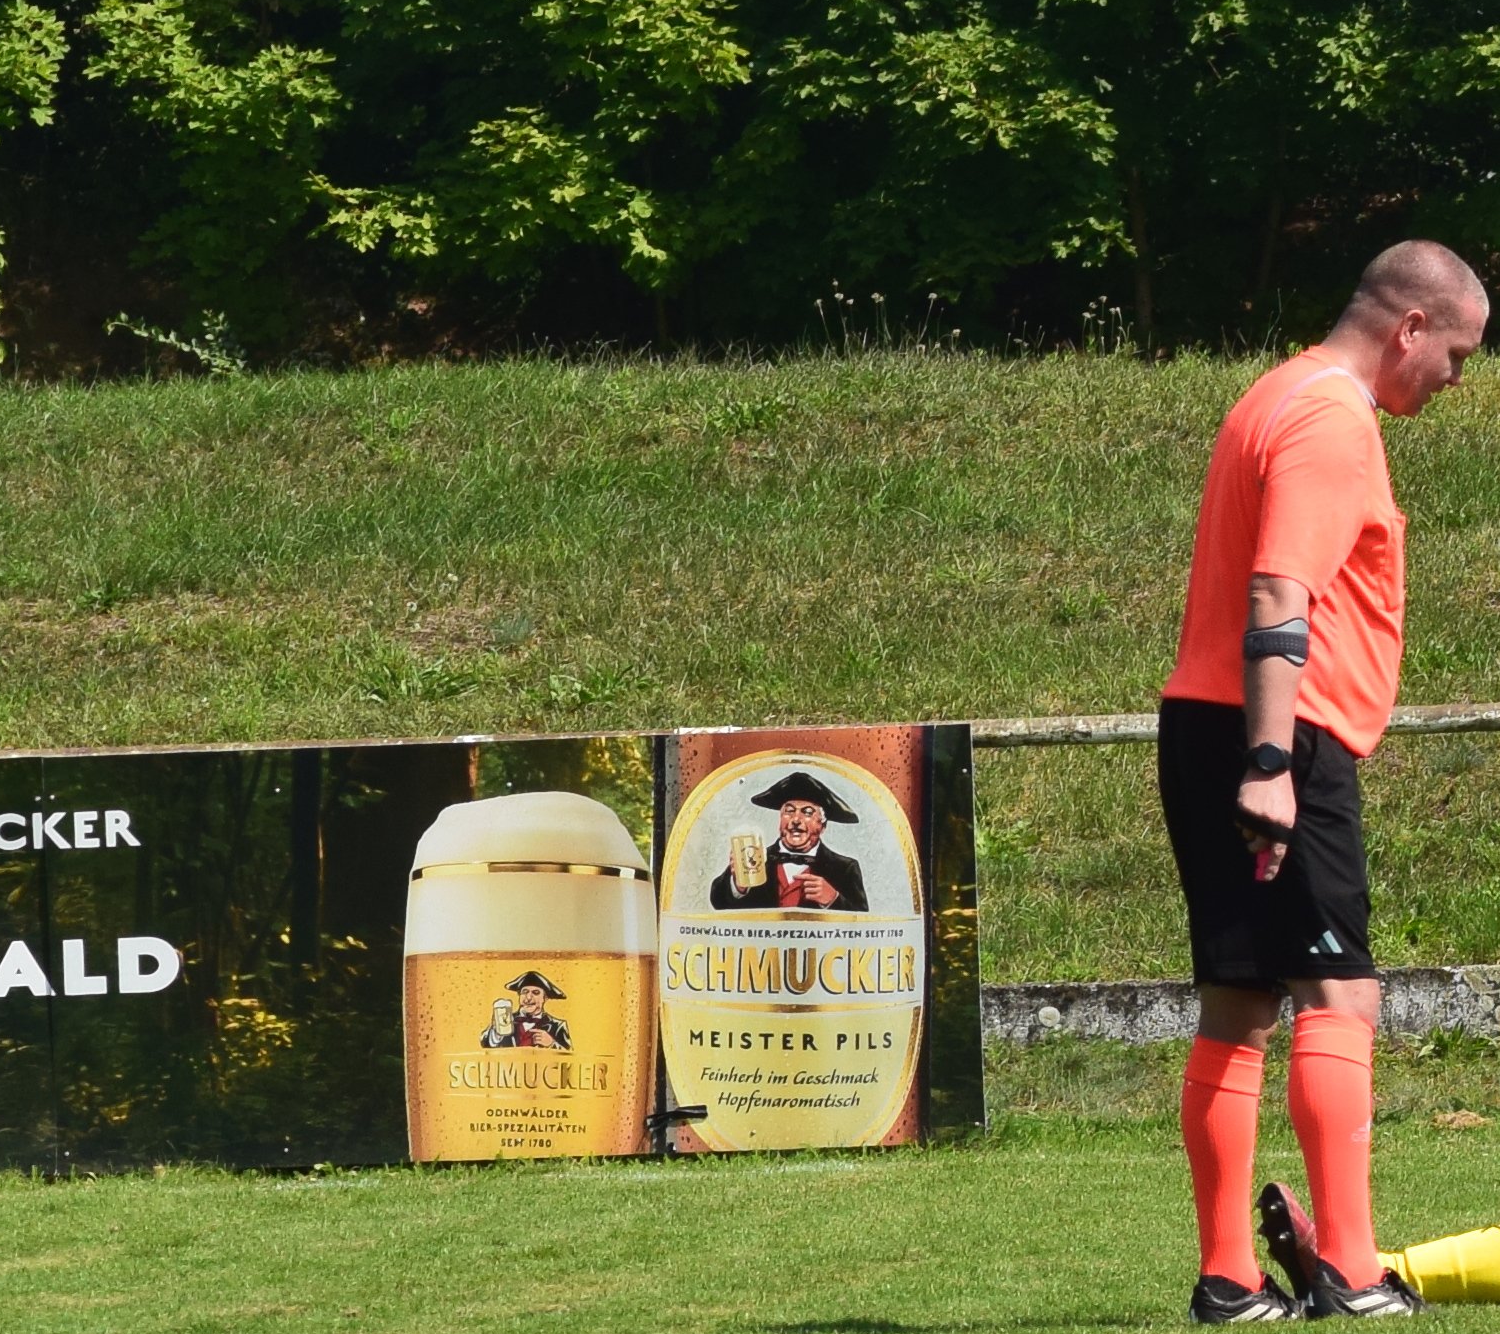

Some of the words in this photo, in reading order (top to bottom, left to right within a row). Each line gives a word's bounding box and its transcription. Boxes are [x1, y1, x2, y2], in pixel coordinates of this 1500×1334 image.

[679, 925, 744, 938] ODENWÄLDER
[747, 927, 862, 939] BIER-SPEZIALITÄTEN
[865, 928, 885, 939] SEIT
[667, 942, 915, 995] SCHMUCKER
[689, 1029, 818, 1051] MEISTER
[836, 1032, 893, 1051] PILS
[449, 1060, 609, 1091] SCHMUCKER
[700, 1066, 762, 1085] Feinherb
[767, 1070, 788, 1085] im
[793, 1066, 879, 1086] Geschmack
[717, 1089, 861, 1114] Hopfenaromatisch
[486, 1107, 569, 1119] ODENWÄLDER
[469, 1123, 587, 1134] BIER-SPEZIALITÄTEN
[529, 1139, 552, 1148] 1780
